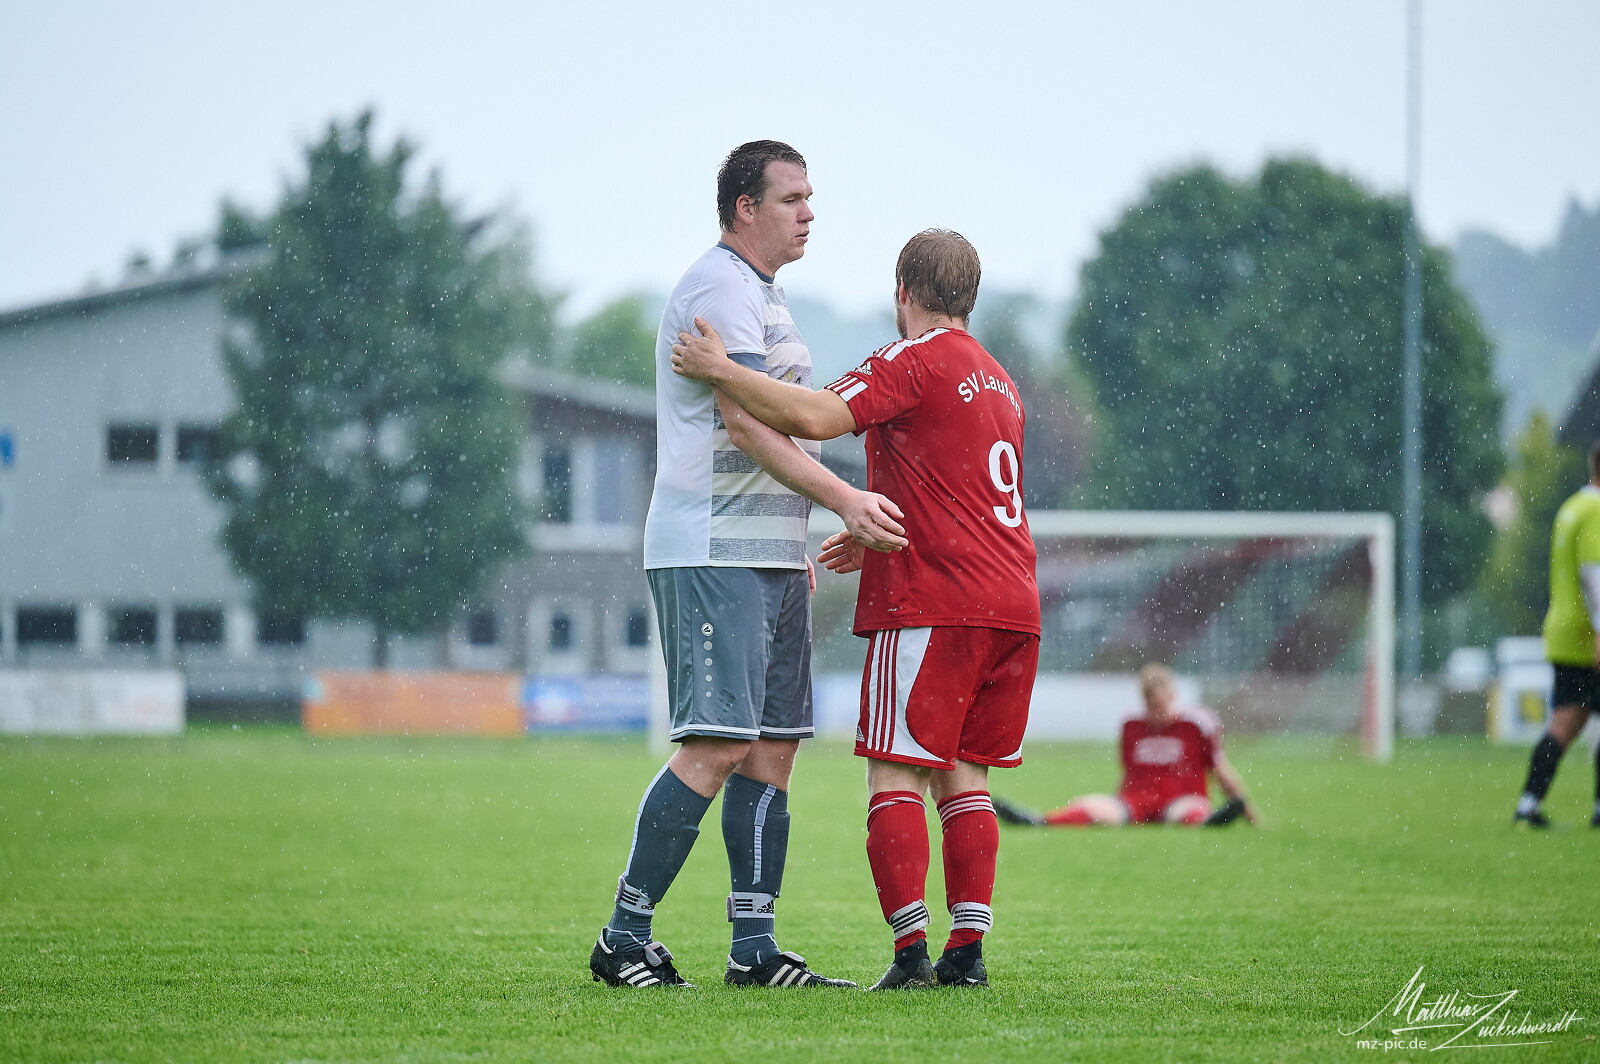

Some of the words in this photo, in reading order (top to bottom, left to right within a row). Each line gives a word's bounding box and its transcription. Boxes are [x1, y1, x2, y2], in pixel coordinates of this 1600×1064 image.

[958, 372, 980, 403] SV
[980, 370, 1022, 419] Laufen
[988, 439, 1023, 528] 9
